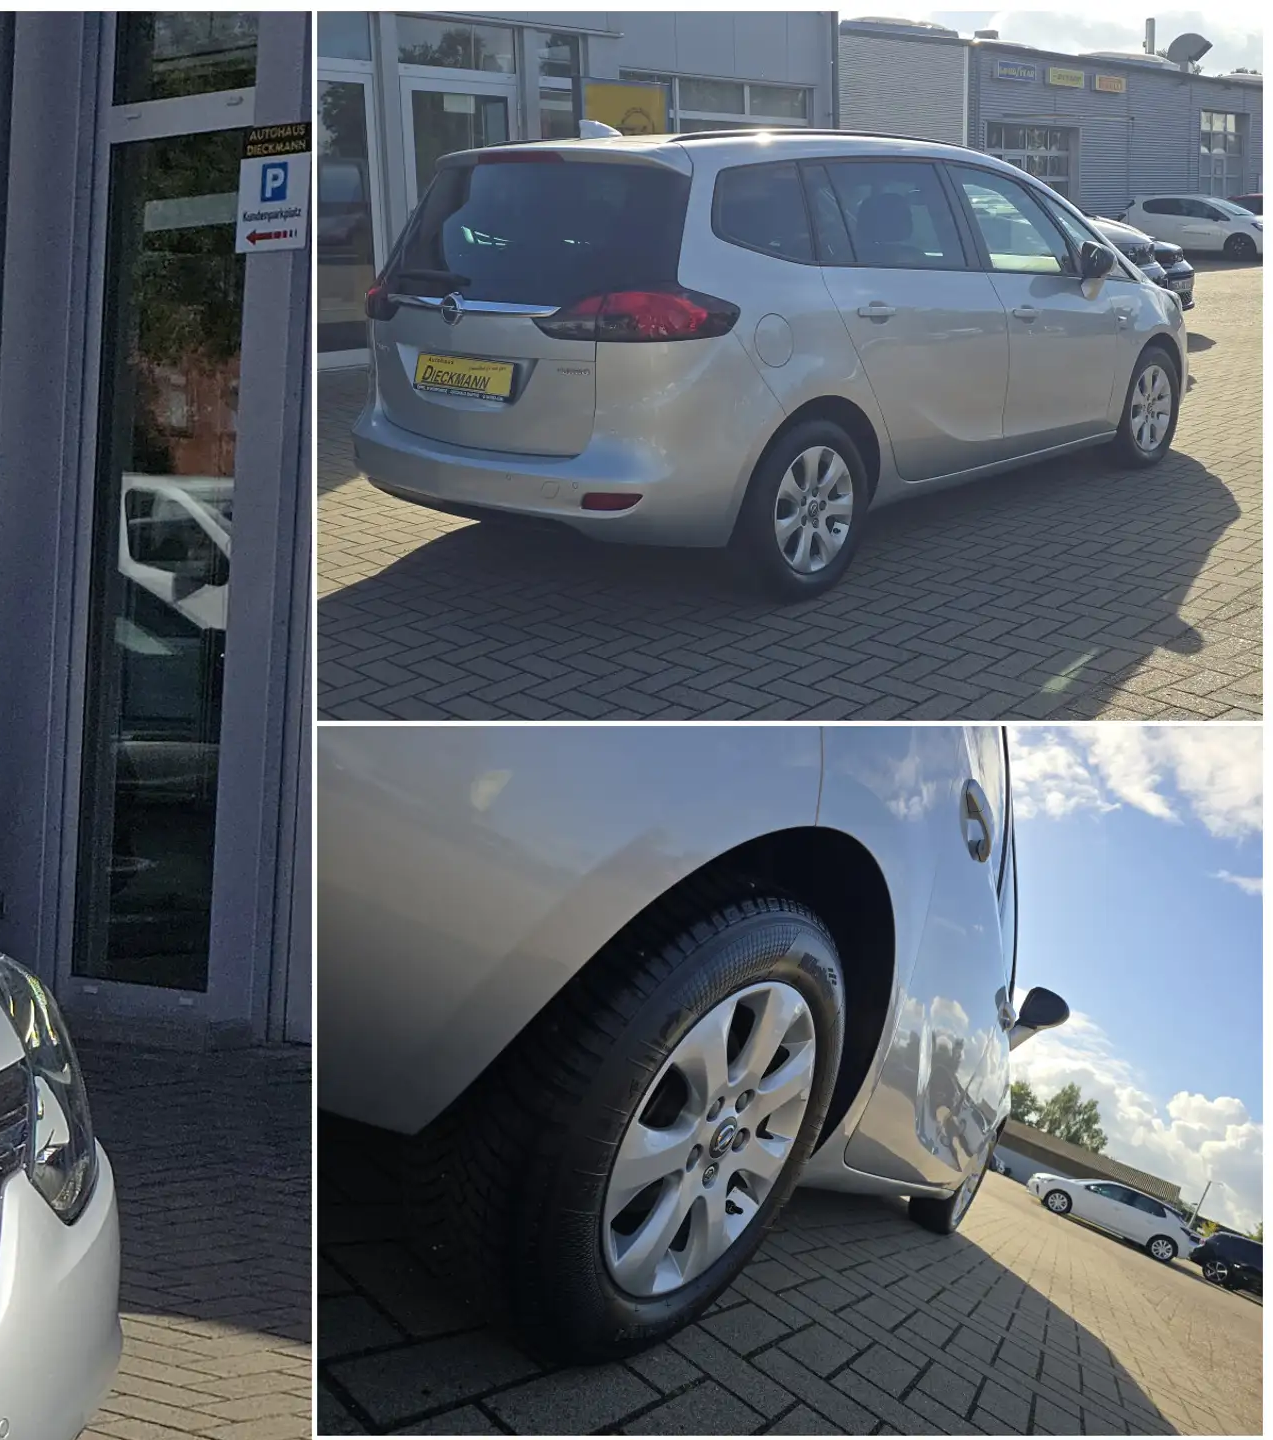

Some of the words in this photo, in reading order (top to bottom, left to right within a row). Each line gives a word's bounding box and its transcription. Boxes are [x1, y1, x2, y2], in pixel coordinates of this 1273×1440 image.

[249, 124, 306, 141] AUTOHAUS
[246, 140, 306, 156] DIECKMANN
[265, 168, 285, 198] P
[243, 208, 302, 223] Kundenparkplatz
[421, 364, 491, 390] DIECKMANN
